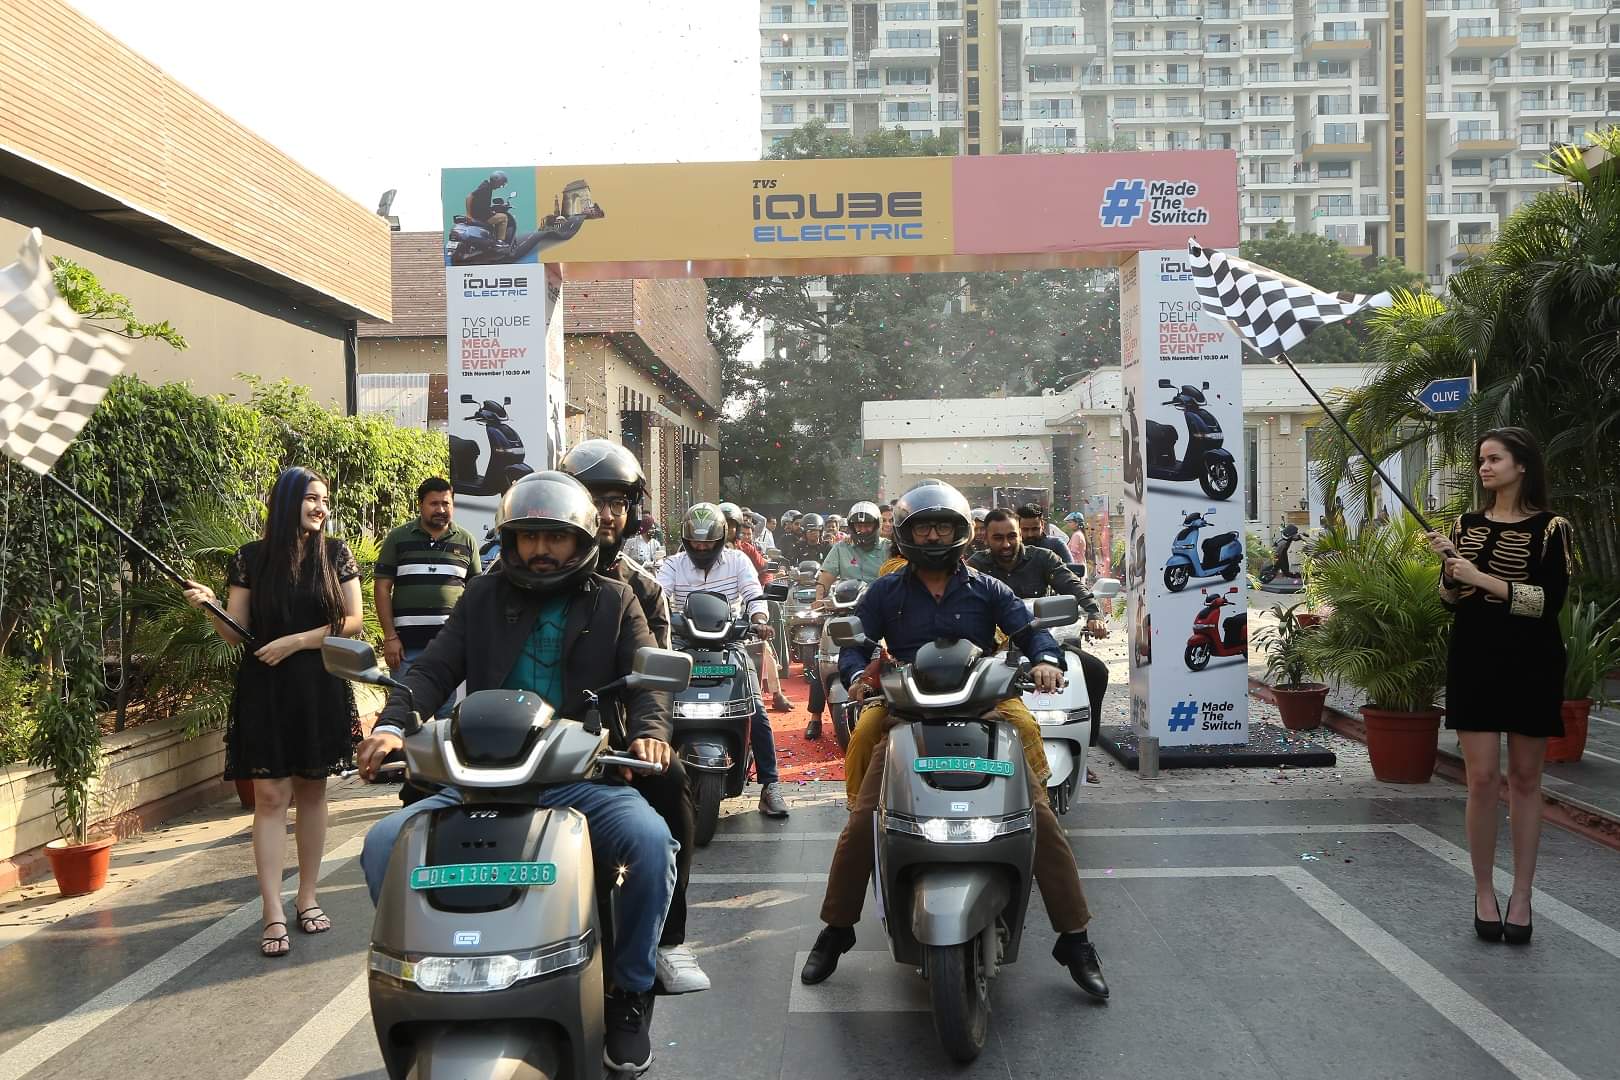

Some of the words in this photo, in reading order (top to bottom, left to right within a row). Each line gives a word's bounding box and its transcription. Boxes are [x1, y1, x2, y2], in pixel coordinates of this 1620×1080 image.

[752, 179, 777, 189] TVS
[1150, 182, 1196, 196] Made
[1151, 196, 1182, 209] The
[1150, 209, 1207, 223] Switch
[753, 223, 923, 243] ELECTRIC
[463, 289, 528, 298] ELECTRIC
[1159, 301, 1184, 312] TVS
[461, 316, 486, 328] TVS
[490, 315, 531, 327] IQUBE
[1159, 312, 1198, 322] DELHI
[462, 327, 500, 339] DELHI
[1159, 323, 1198, 334] MEGA
[461, 338, 501, 349] MEGA
[1159, 333, 1225, 344] DELIVERY
[461, 348, 527, 359] DELIVERY
[1159, 343, 1204, 354] EVENT
[461, 359, 506, 370] EVENT
[1431, 390, 1460, 402] OLIVE
[1201, 701, 1234, 711] Made
[1202, 711, 1224, 720] The
[1201, 720, 1242, 731] Switch
[982, 761, 1010, 774] 3250
[430, 869, 449, 885] DL
[509, 865, 551, 882] 2836
